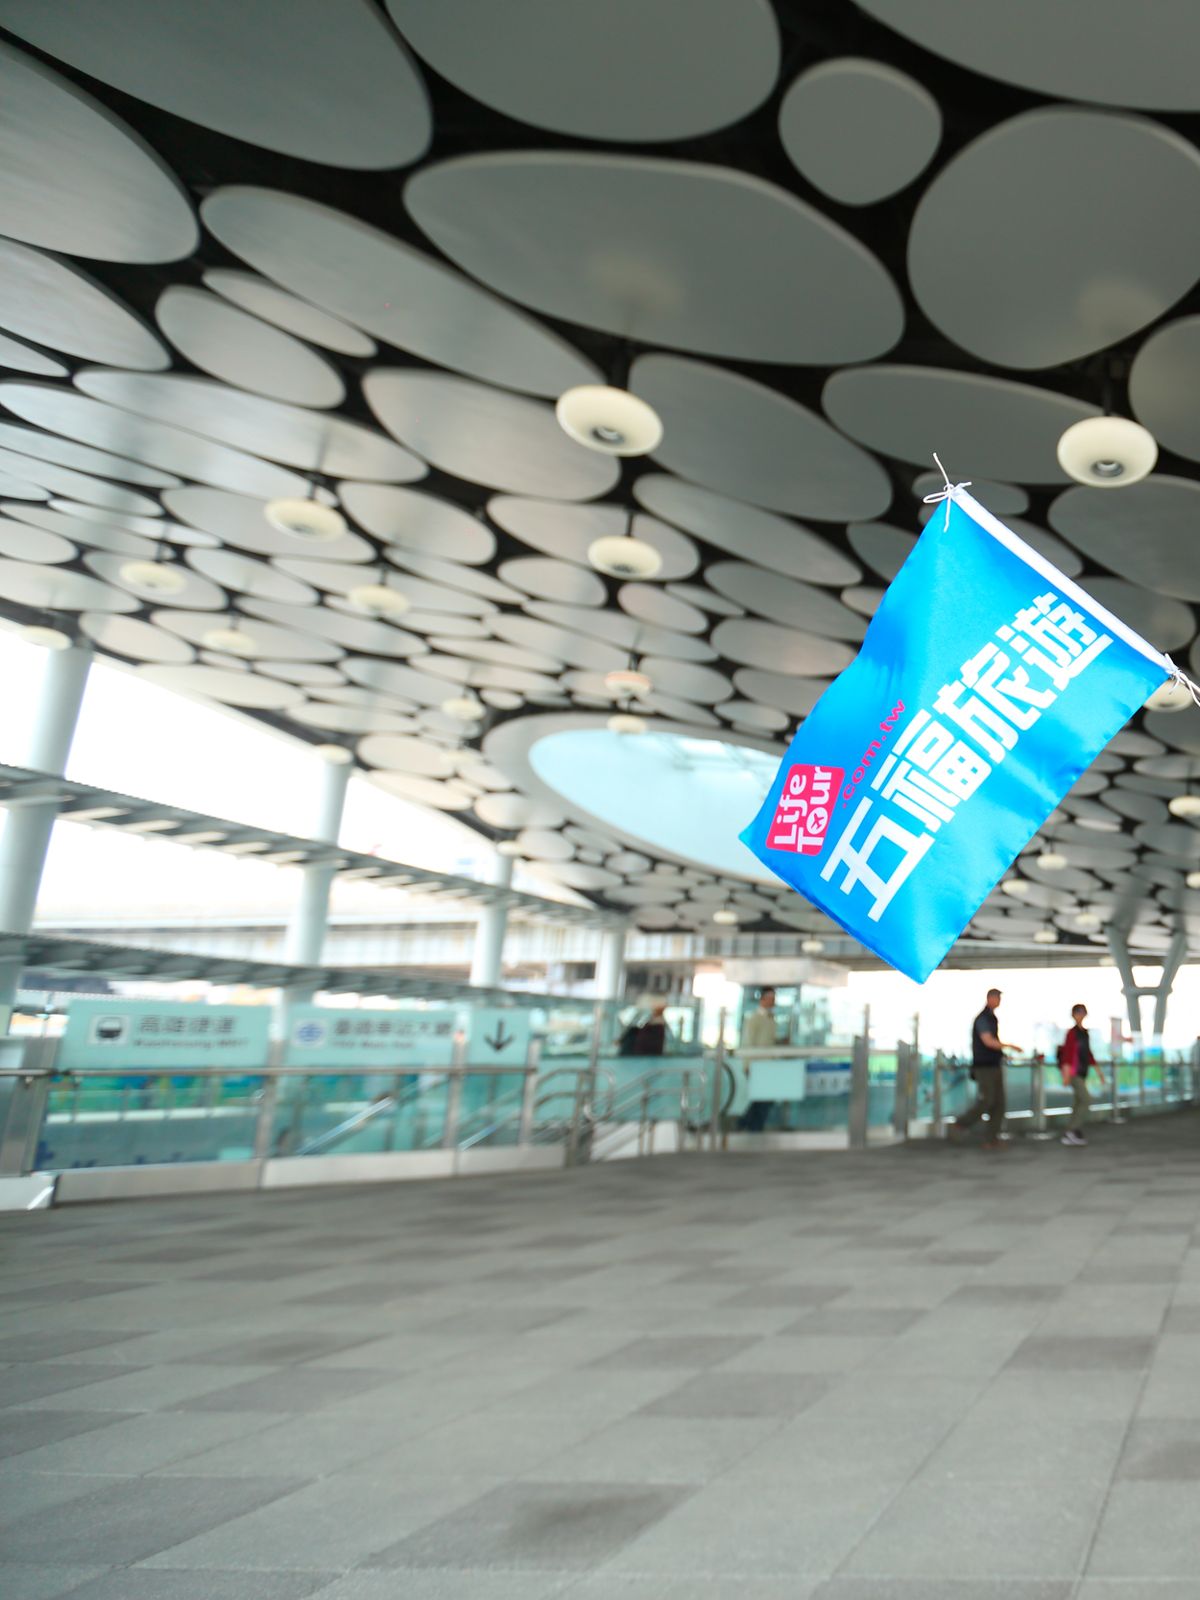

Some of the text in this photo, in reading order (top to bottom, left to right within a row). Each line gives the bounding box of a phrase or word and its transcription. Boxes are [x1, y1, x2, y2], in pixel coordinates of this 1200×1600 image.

[820, 592, 1113, 922] 五福旅遊
[842, 699, 906, 810] .com.tw
[773, 774, 808, 845] Life
[797, 766, 833, 853] Tour
